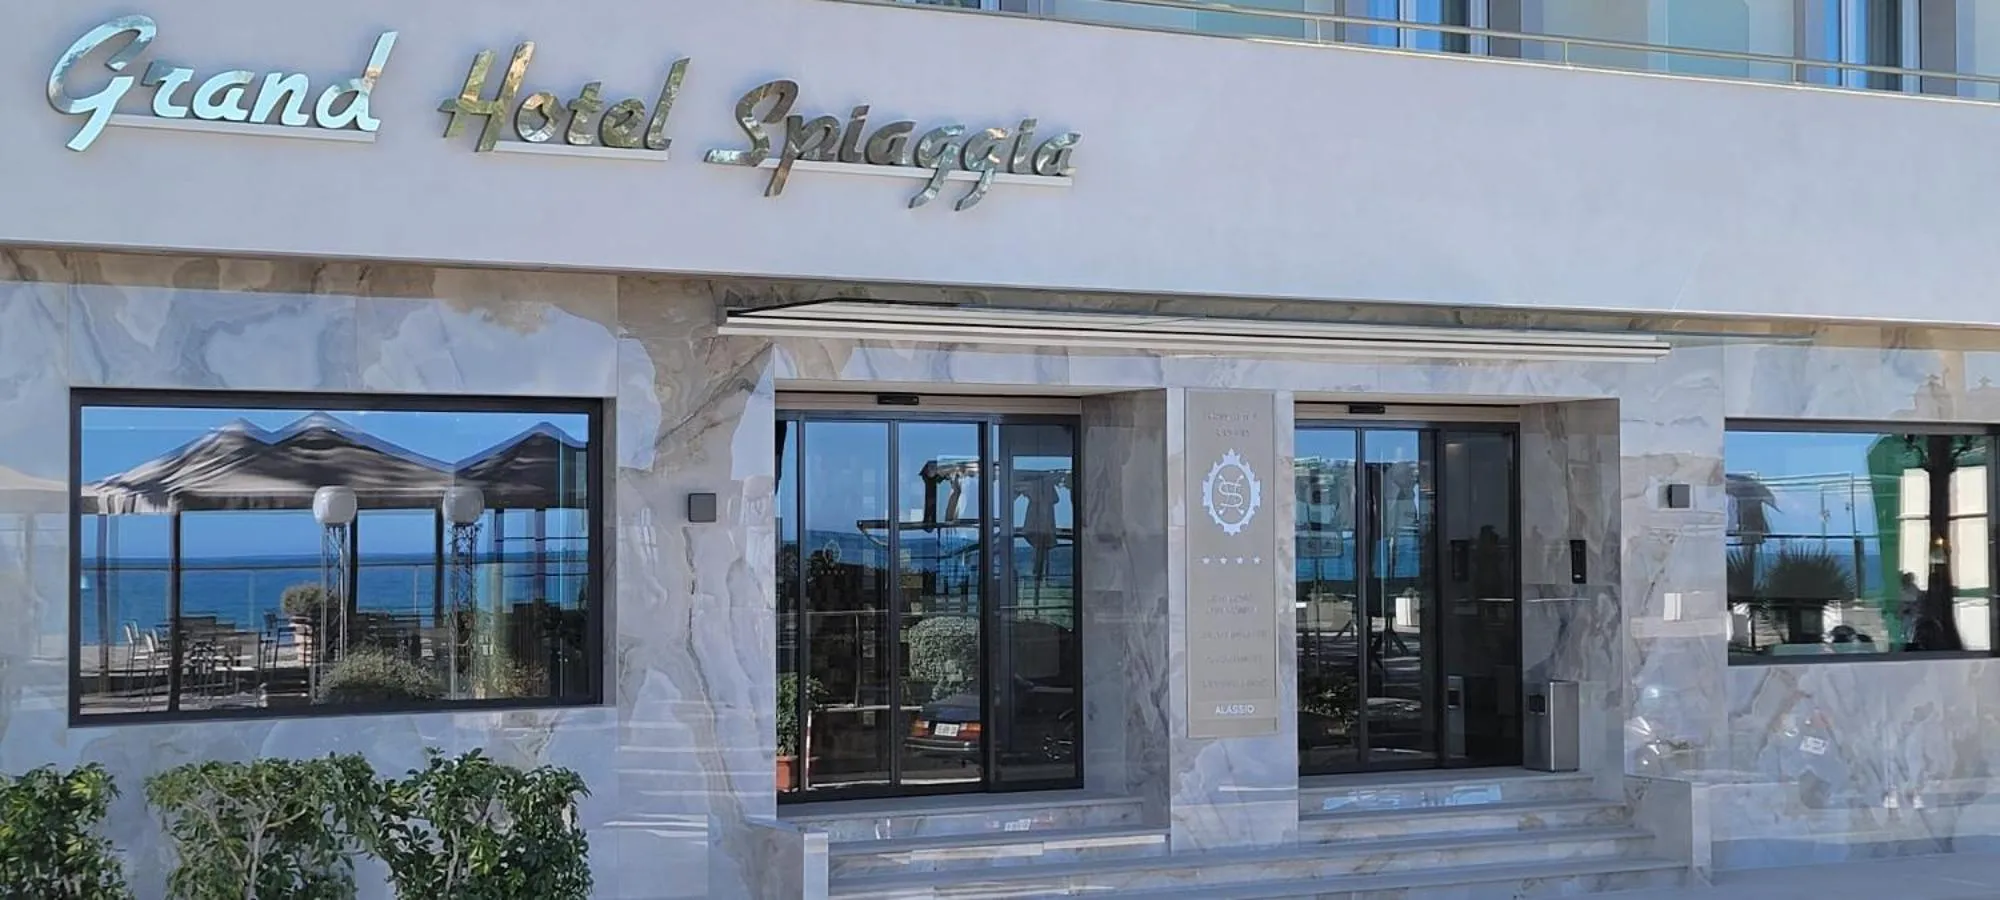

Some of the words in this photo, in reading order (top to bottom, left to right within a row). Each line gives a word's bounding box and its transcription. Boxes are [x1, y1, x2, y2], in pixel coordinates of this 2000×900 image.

[47, 14, 398, 151] Grand
[438, 40, 691, 152] Hotel
[703, 79, 1081, 211] Spiaggia
[1215, 704, 1255, 714] ALASSIO
